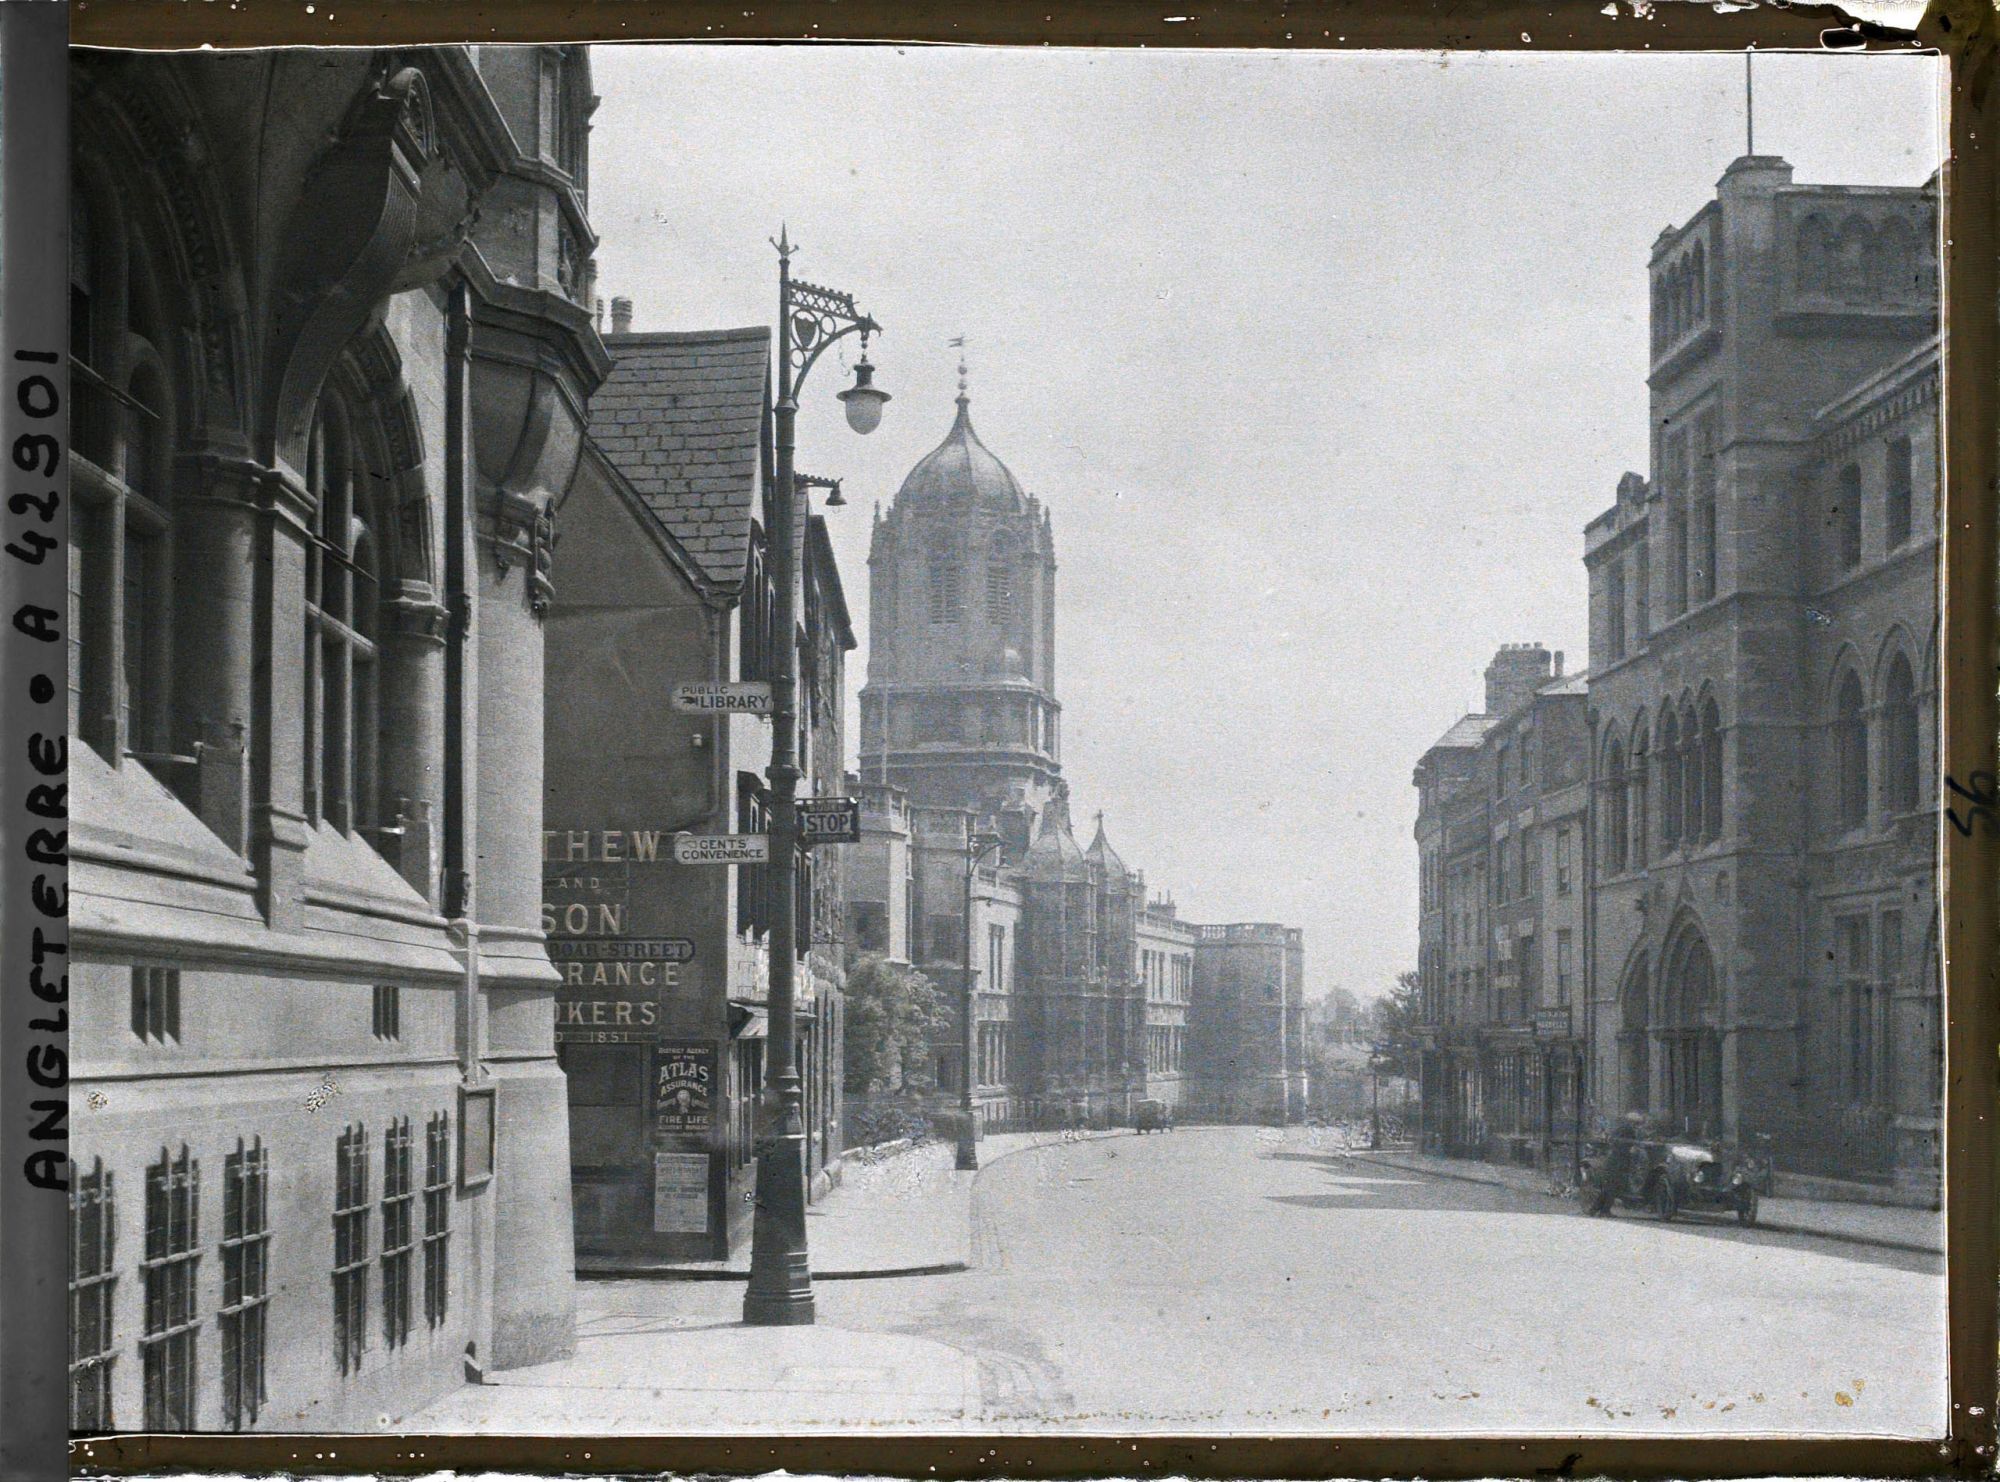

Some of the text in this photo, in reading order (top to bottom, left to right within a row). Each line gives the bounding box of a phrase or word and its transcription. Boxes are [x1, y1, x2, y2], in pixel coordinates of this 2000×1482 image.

[682, 686, 729, 695] PUBLIC
[701, 695, 769, 709] LIBRARY
[4, 349, 69, 1192] ANGLETERRE A 42901
[806, 814, 849, 832] STOP
[542, 830, 692, 862] THEW
[682, 849, 764, 859] CONVENIENCE
[558, 877, 601, 888] AND
[607, 943, 688, 958] STREET
[554, 961, 680, 986] RANCE
[590, 1031, 628, 1042] 1851
[658, 1062, 709, 1084] ATLAS
[661, 1080, 707, 1097] ASSURANCE
[659, 1115, 709, 1124] FIRE LIFE
